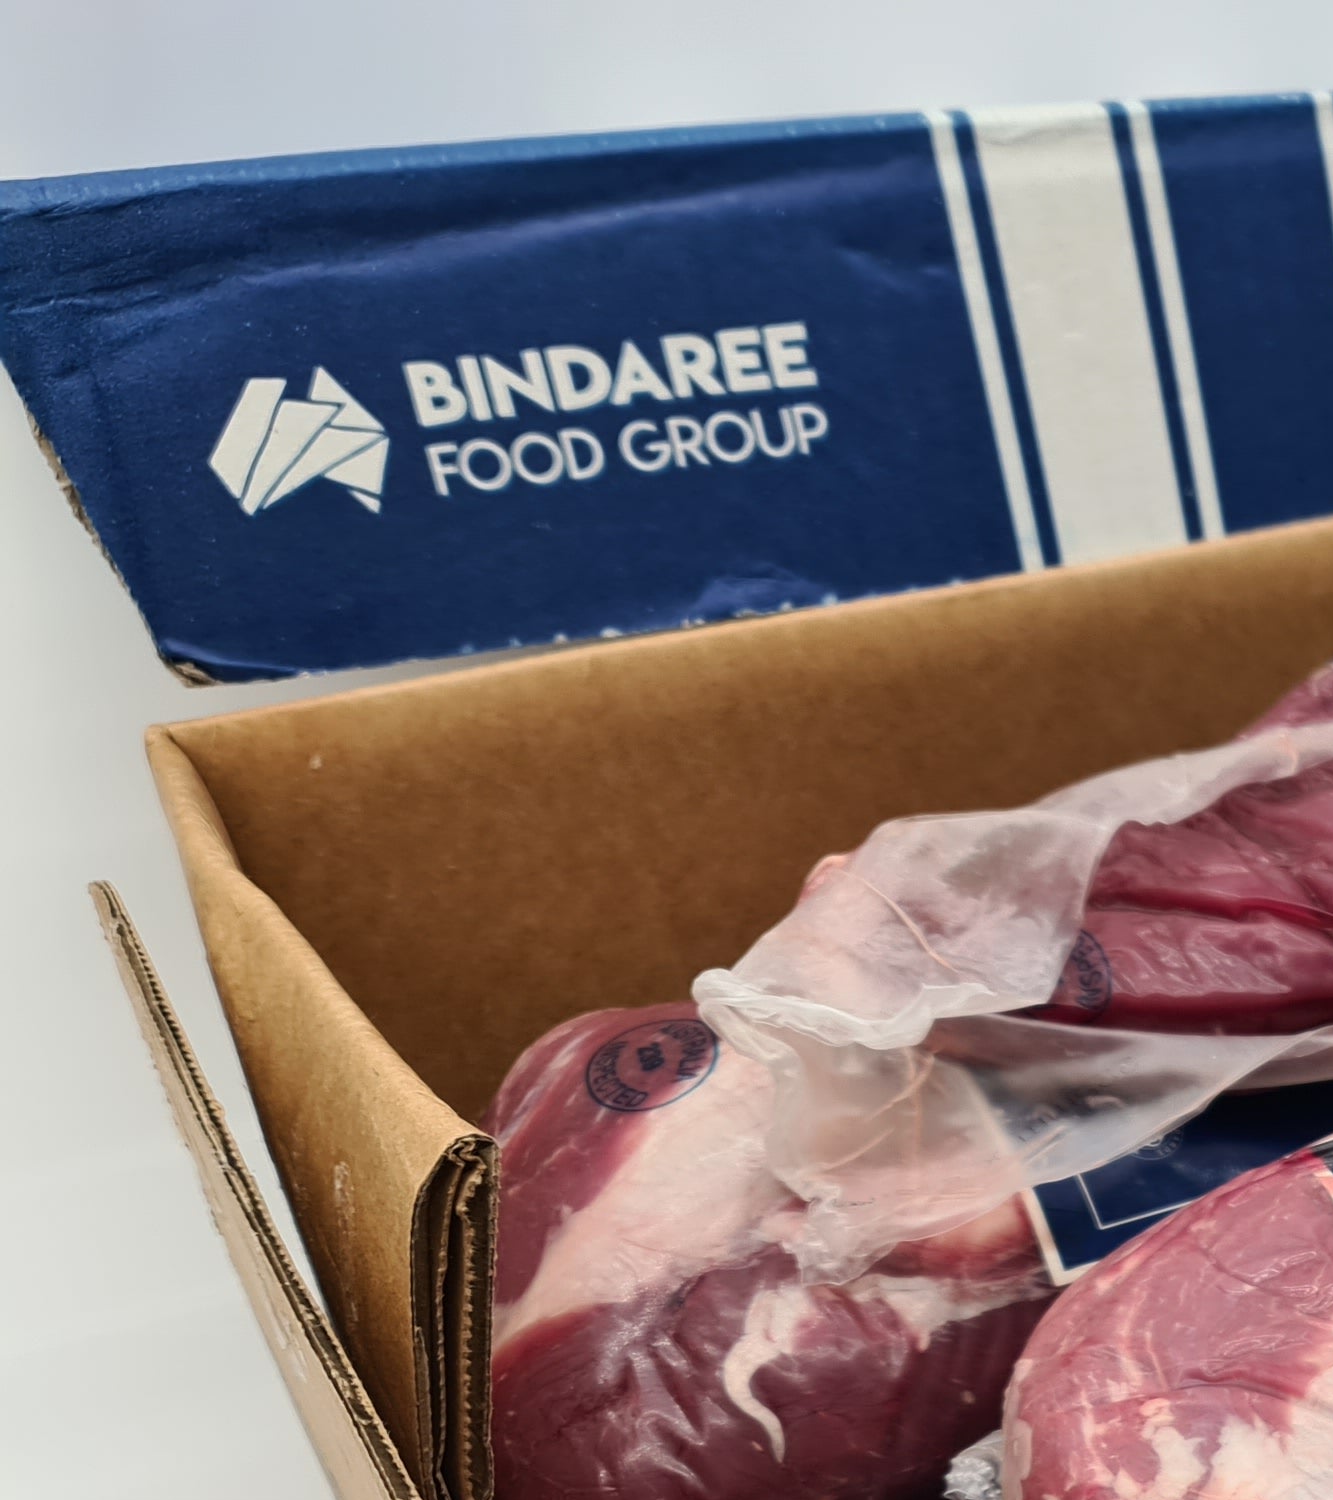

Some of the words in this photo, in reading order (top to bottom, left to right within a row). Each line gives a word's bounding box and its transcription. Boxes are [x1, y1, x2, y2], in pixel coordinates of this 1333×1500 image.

[402, 322, 818, 427] BINDAREE
[425, 427, 605, 496] FOOD
[618, 403, 829, 473] GROUP
